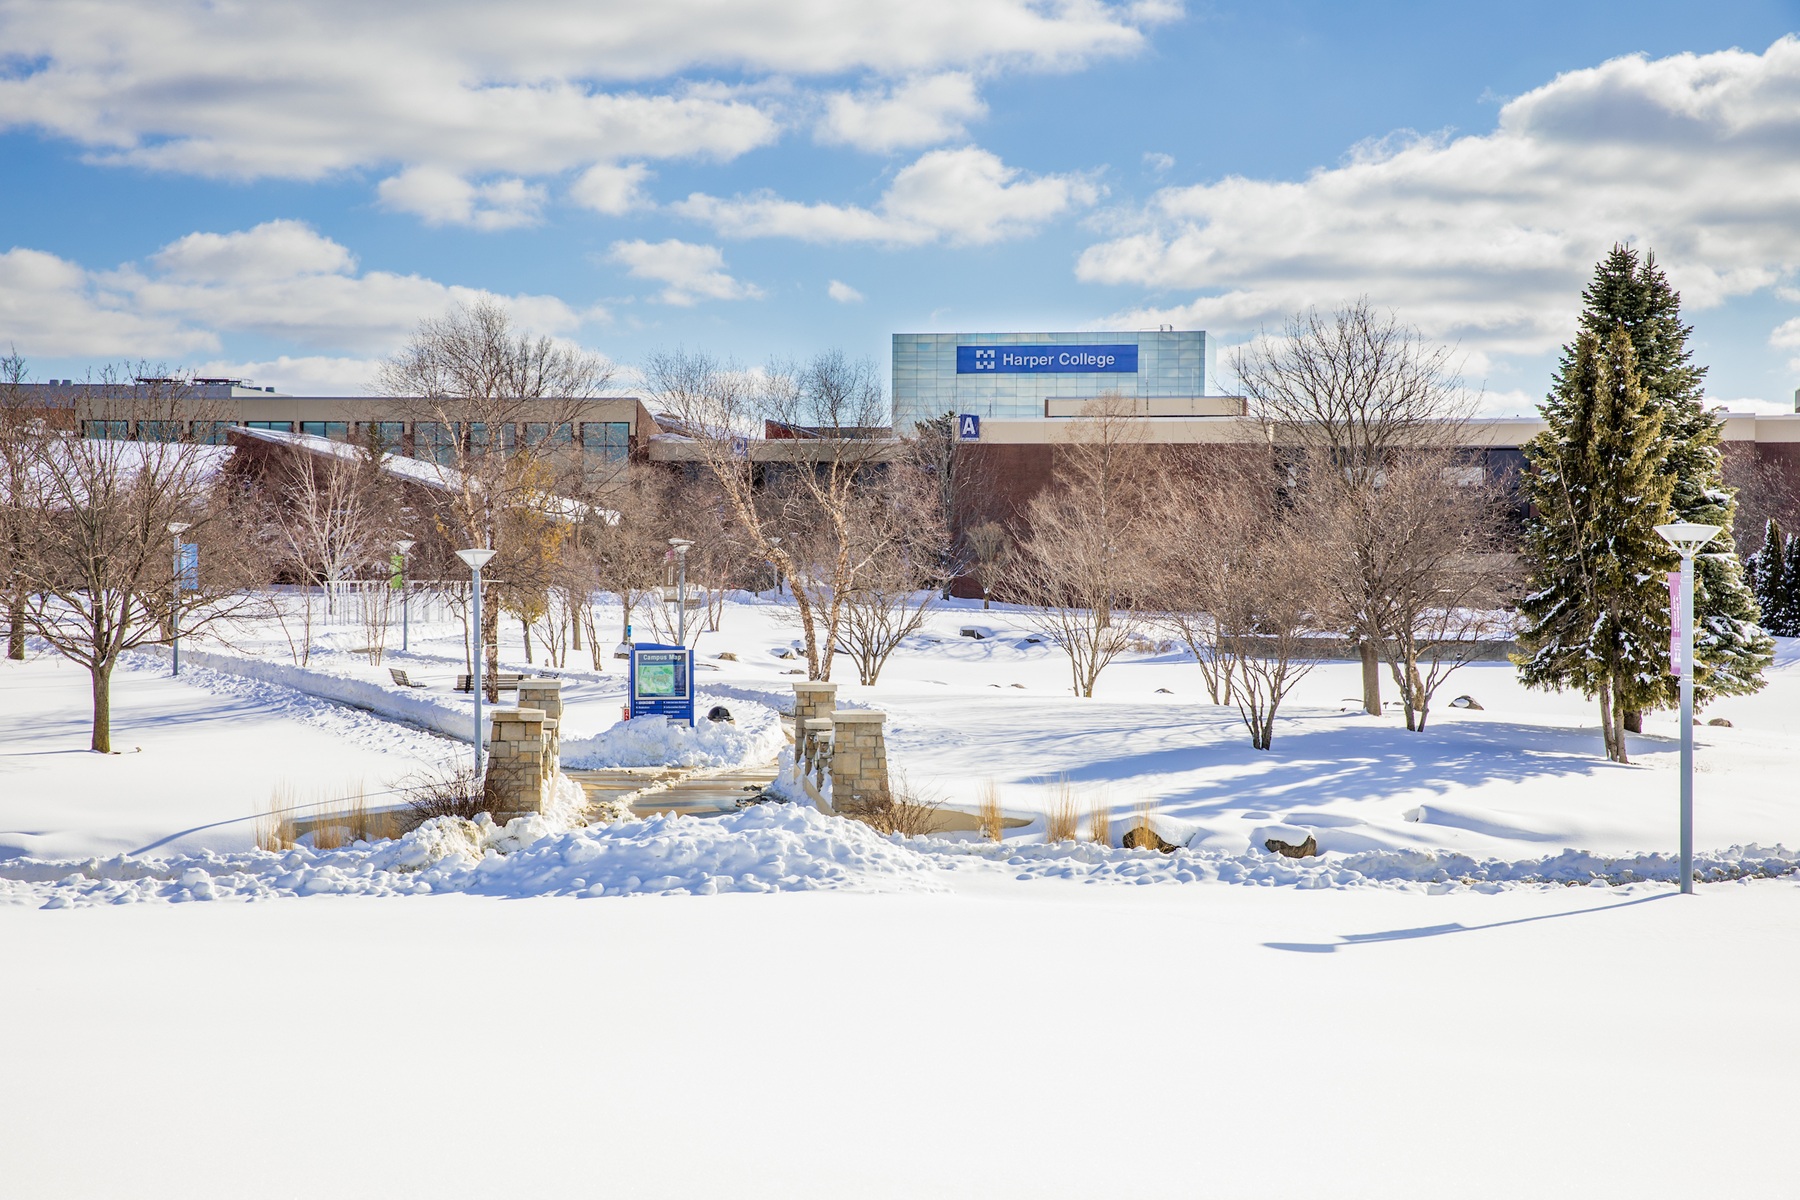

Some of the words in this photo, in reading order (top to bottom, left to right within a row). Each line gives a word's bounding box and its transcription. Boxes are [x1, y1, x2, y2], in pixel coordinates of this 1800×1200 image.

[1002, 353, 1054, 368] Harper
[1059, 352, 1115, 368] College
[962, 417, 976, 435] A
